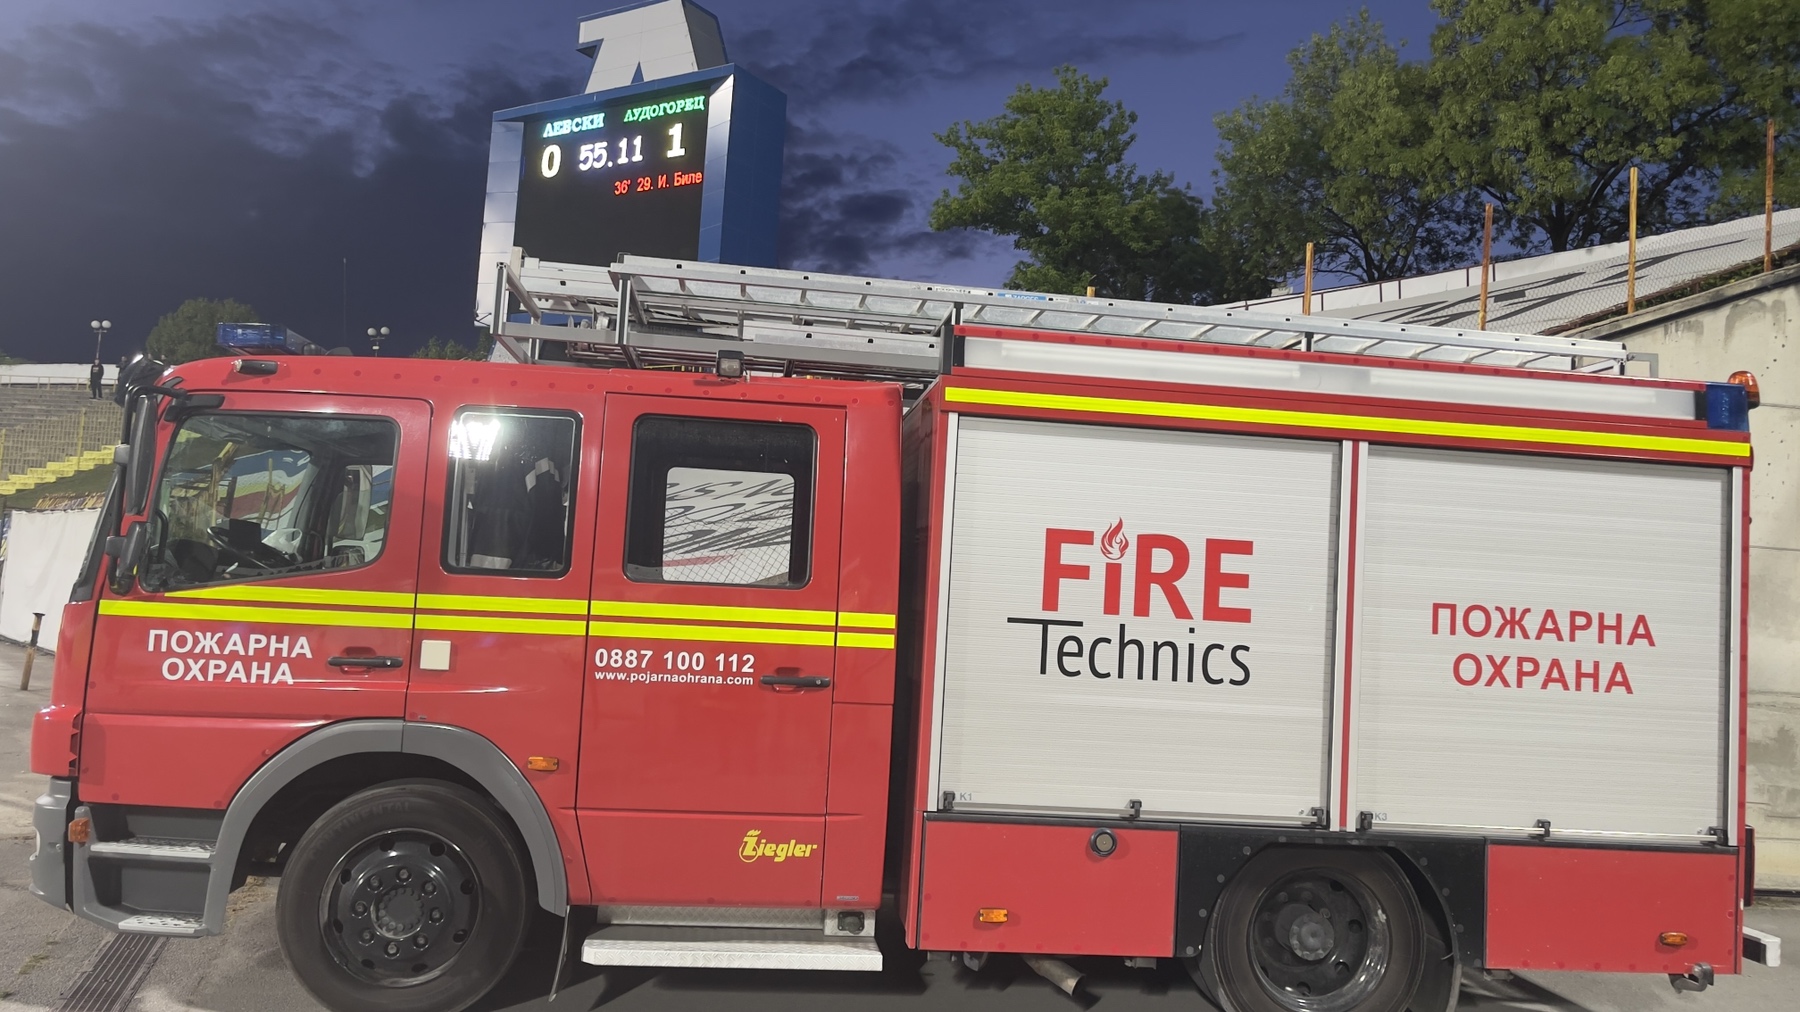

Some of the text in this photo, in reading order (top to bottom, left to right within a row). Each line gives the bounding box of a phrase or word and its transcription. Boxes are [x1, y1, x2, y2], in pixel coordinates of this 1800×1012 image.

[623, 95, 706, 123] ЛУДОГОРЕЦ
[542, 113, 606, 139] ЛЕВСКИ
[666, 122, 686, 158] 1
[541, 144, 562, 178] 0
[578, 135, 644, 172] 55.11
[636, 177, 654, 193] 29.
[657, 174, 670, 189] И.
[1431, 602, 1656, 647] ПОЖАРНА
[147, 629, 313, 659] ПОЖАРНА
[1006, 617, 1251, 686] Technics
[161, 657, 294, 685] ОХРАНА
[594, 648, 755, 673] 0887 100 112
[1452, 652, 1634, 695] ОХРАНА
[594, 670, 754, 686] www.pojarnaohrana.com
[959, 792, 973, 801] K1
[1374, 812, 1388, 821] K3
[738, 829, 818, 863] Ziegler
